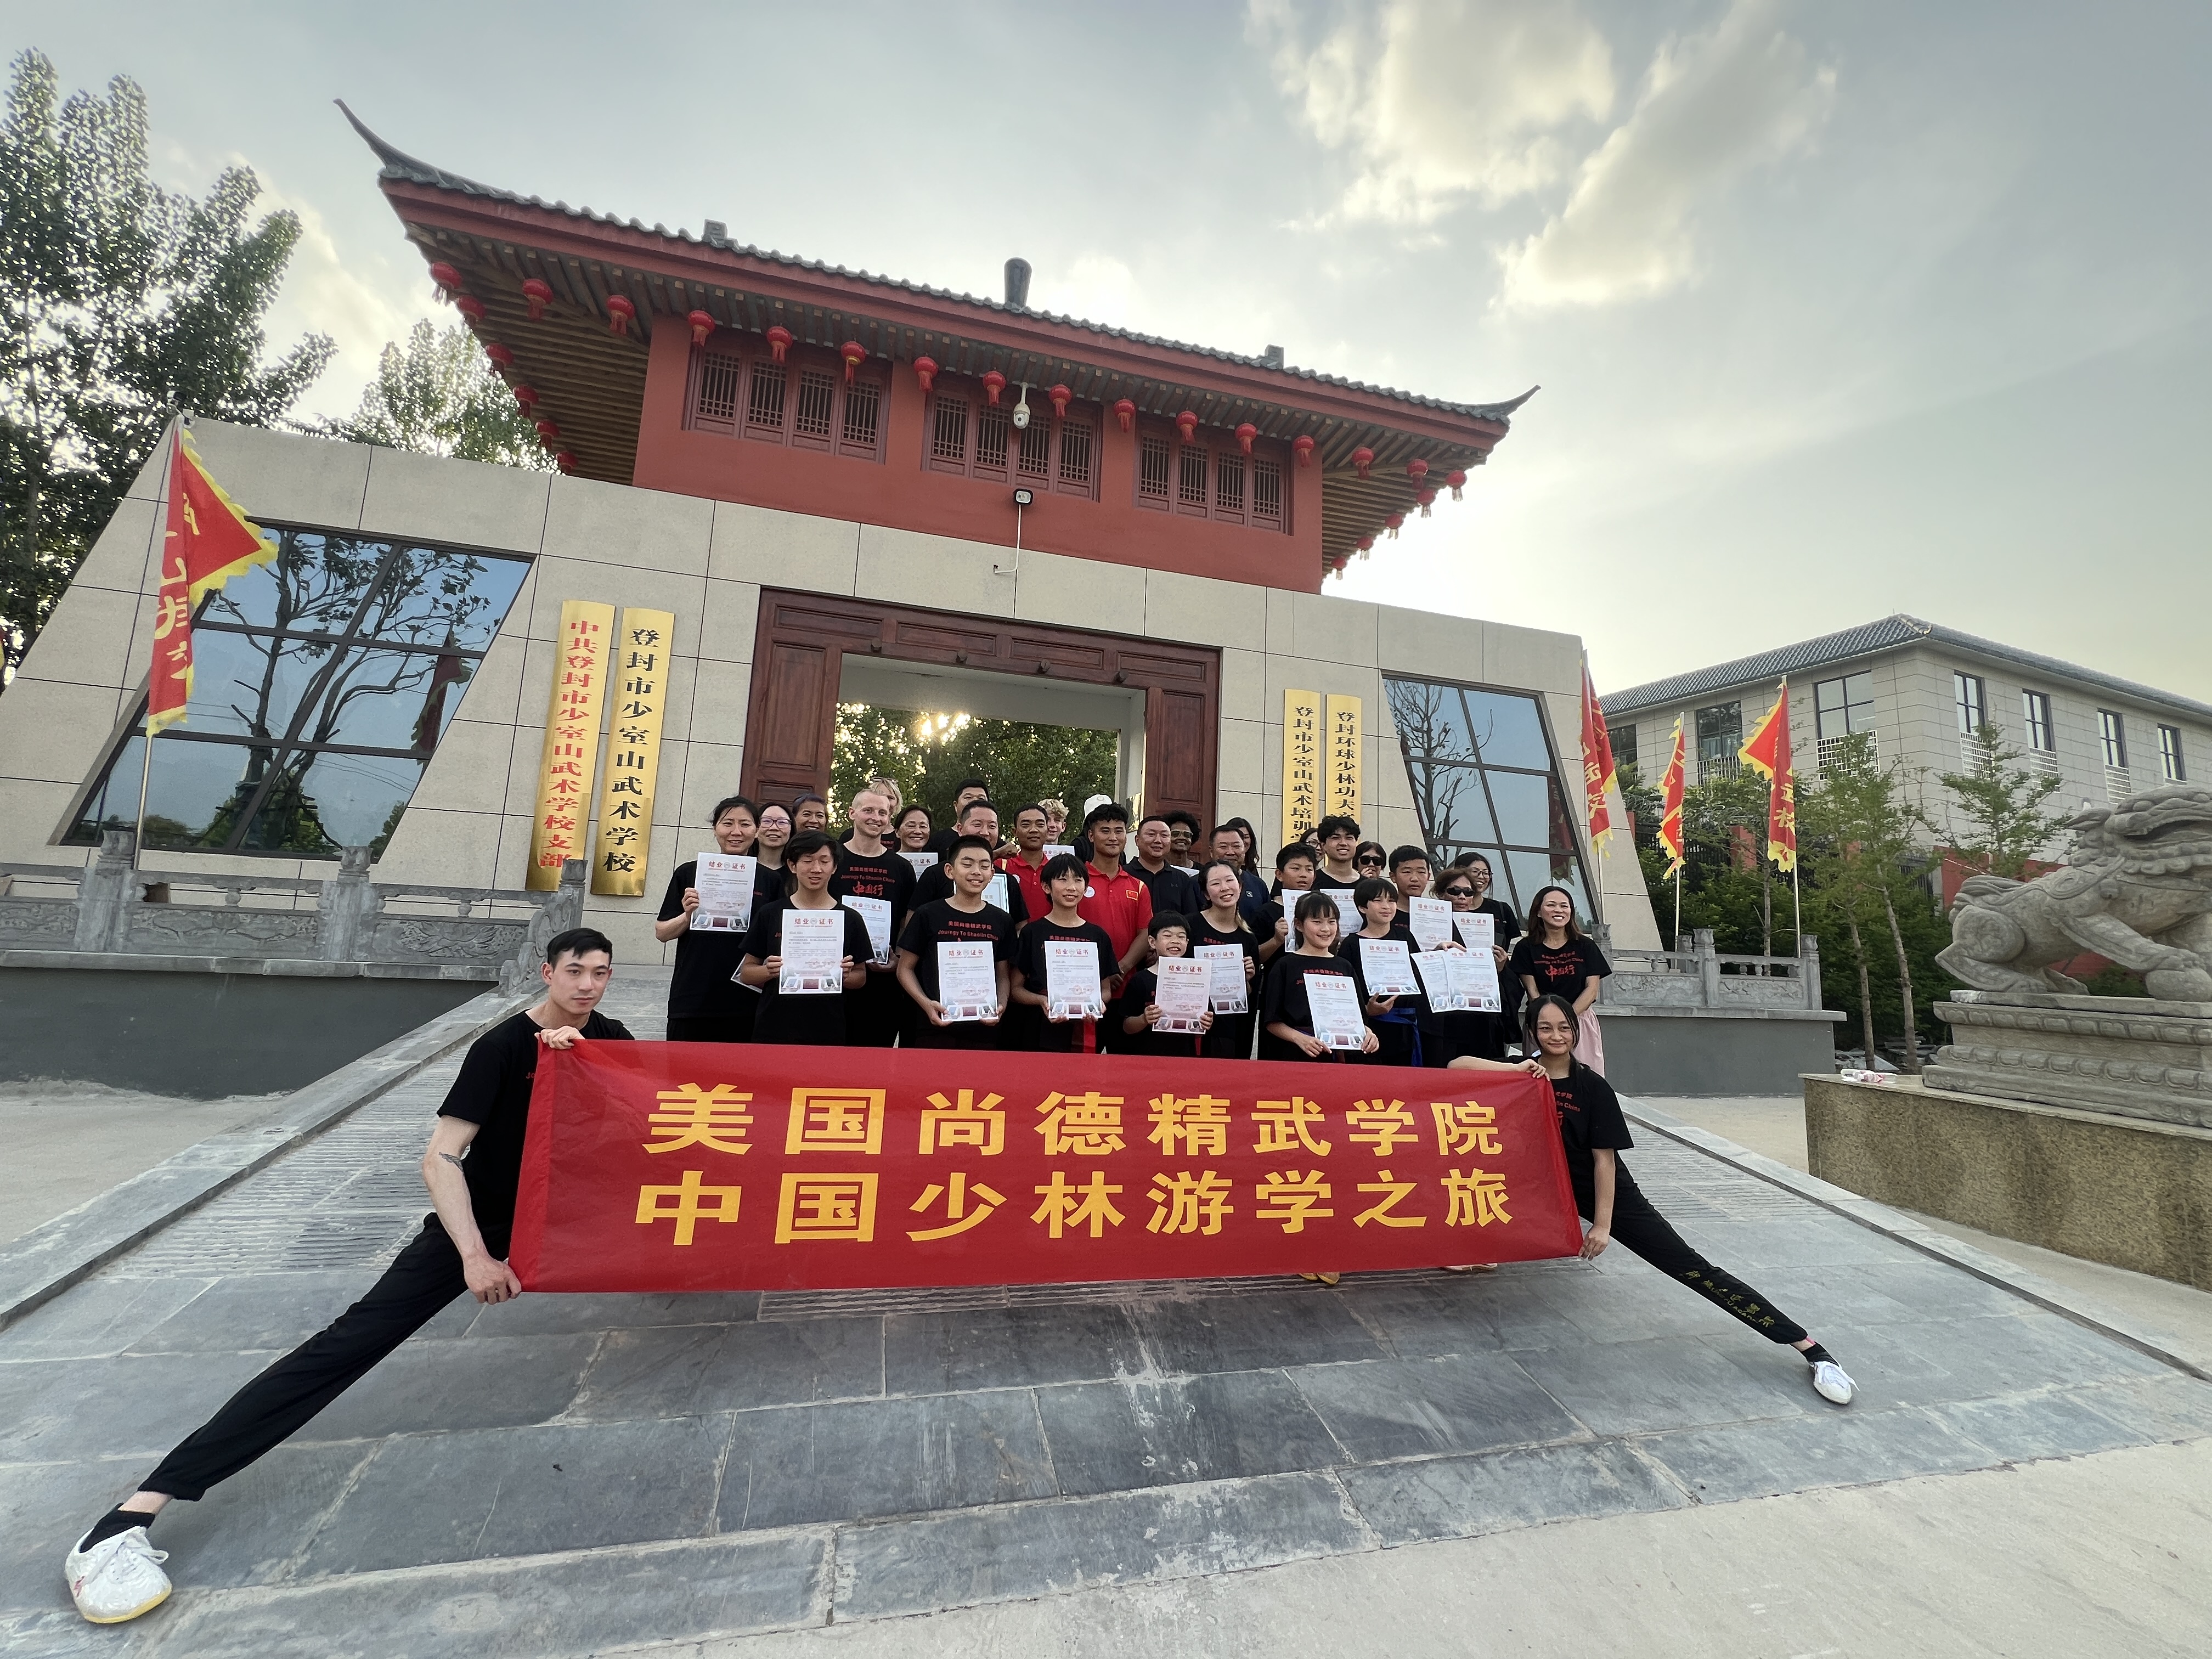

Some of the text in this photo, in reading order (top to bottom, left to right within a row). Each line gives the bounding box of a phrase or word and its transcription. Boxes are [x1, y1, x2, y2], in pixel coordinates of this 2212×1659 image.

[539, 620, 599, 868] 中共登封市少室山武术学校支部
[603, 628, 660, 872] 登封市少室山武术学校
[708, 861, 746, 870] 结业证书
[642, 1082, 1503, 1157] 美国尚德精武学院
[635, 1169, 1513, 1246] 中国少林游学之旅
